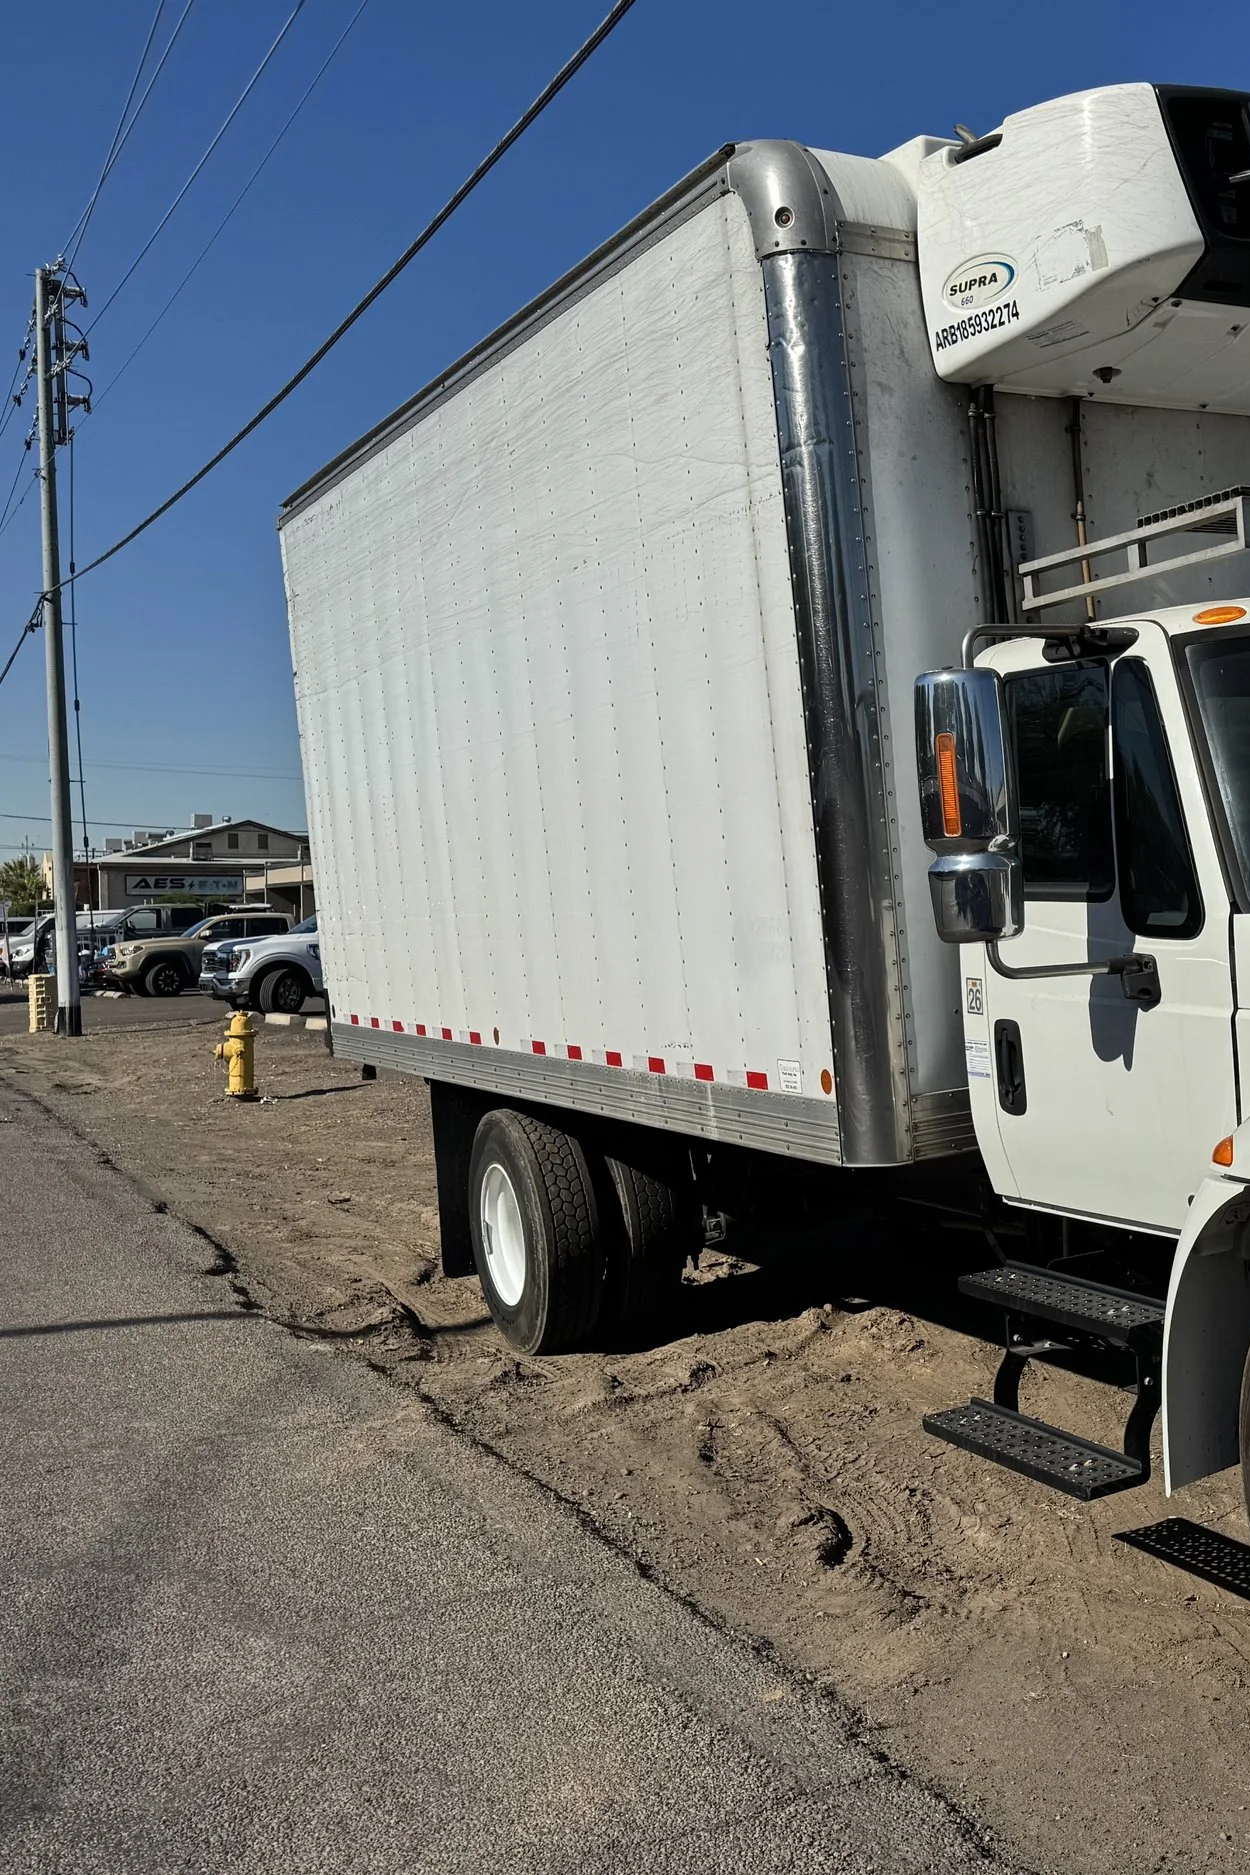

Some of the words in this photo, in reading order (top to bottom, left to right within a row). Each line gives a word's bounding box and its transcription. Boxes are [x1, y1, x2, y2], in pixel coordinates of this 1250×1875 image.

[949, 272, 998, 297] SUPRA
[935, 300, 1020, 352] ARB185932274
[132, 877, 186, 889] AES
[968, 988, 982, 1012] 26
